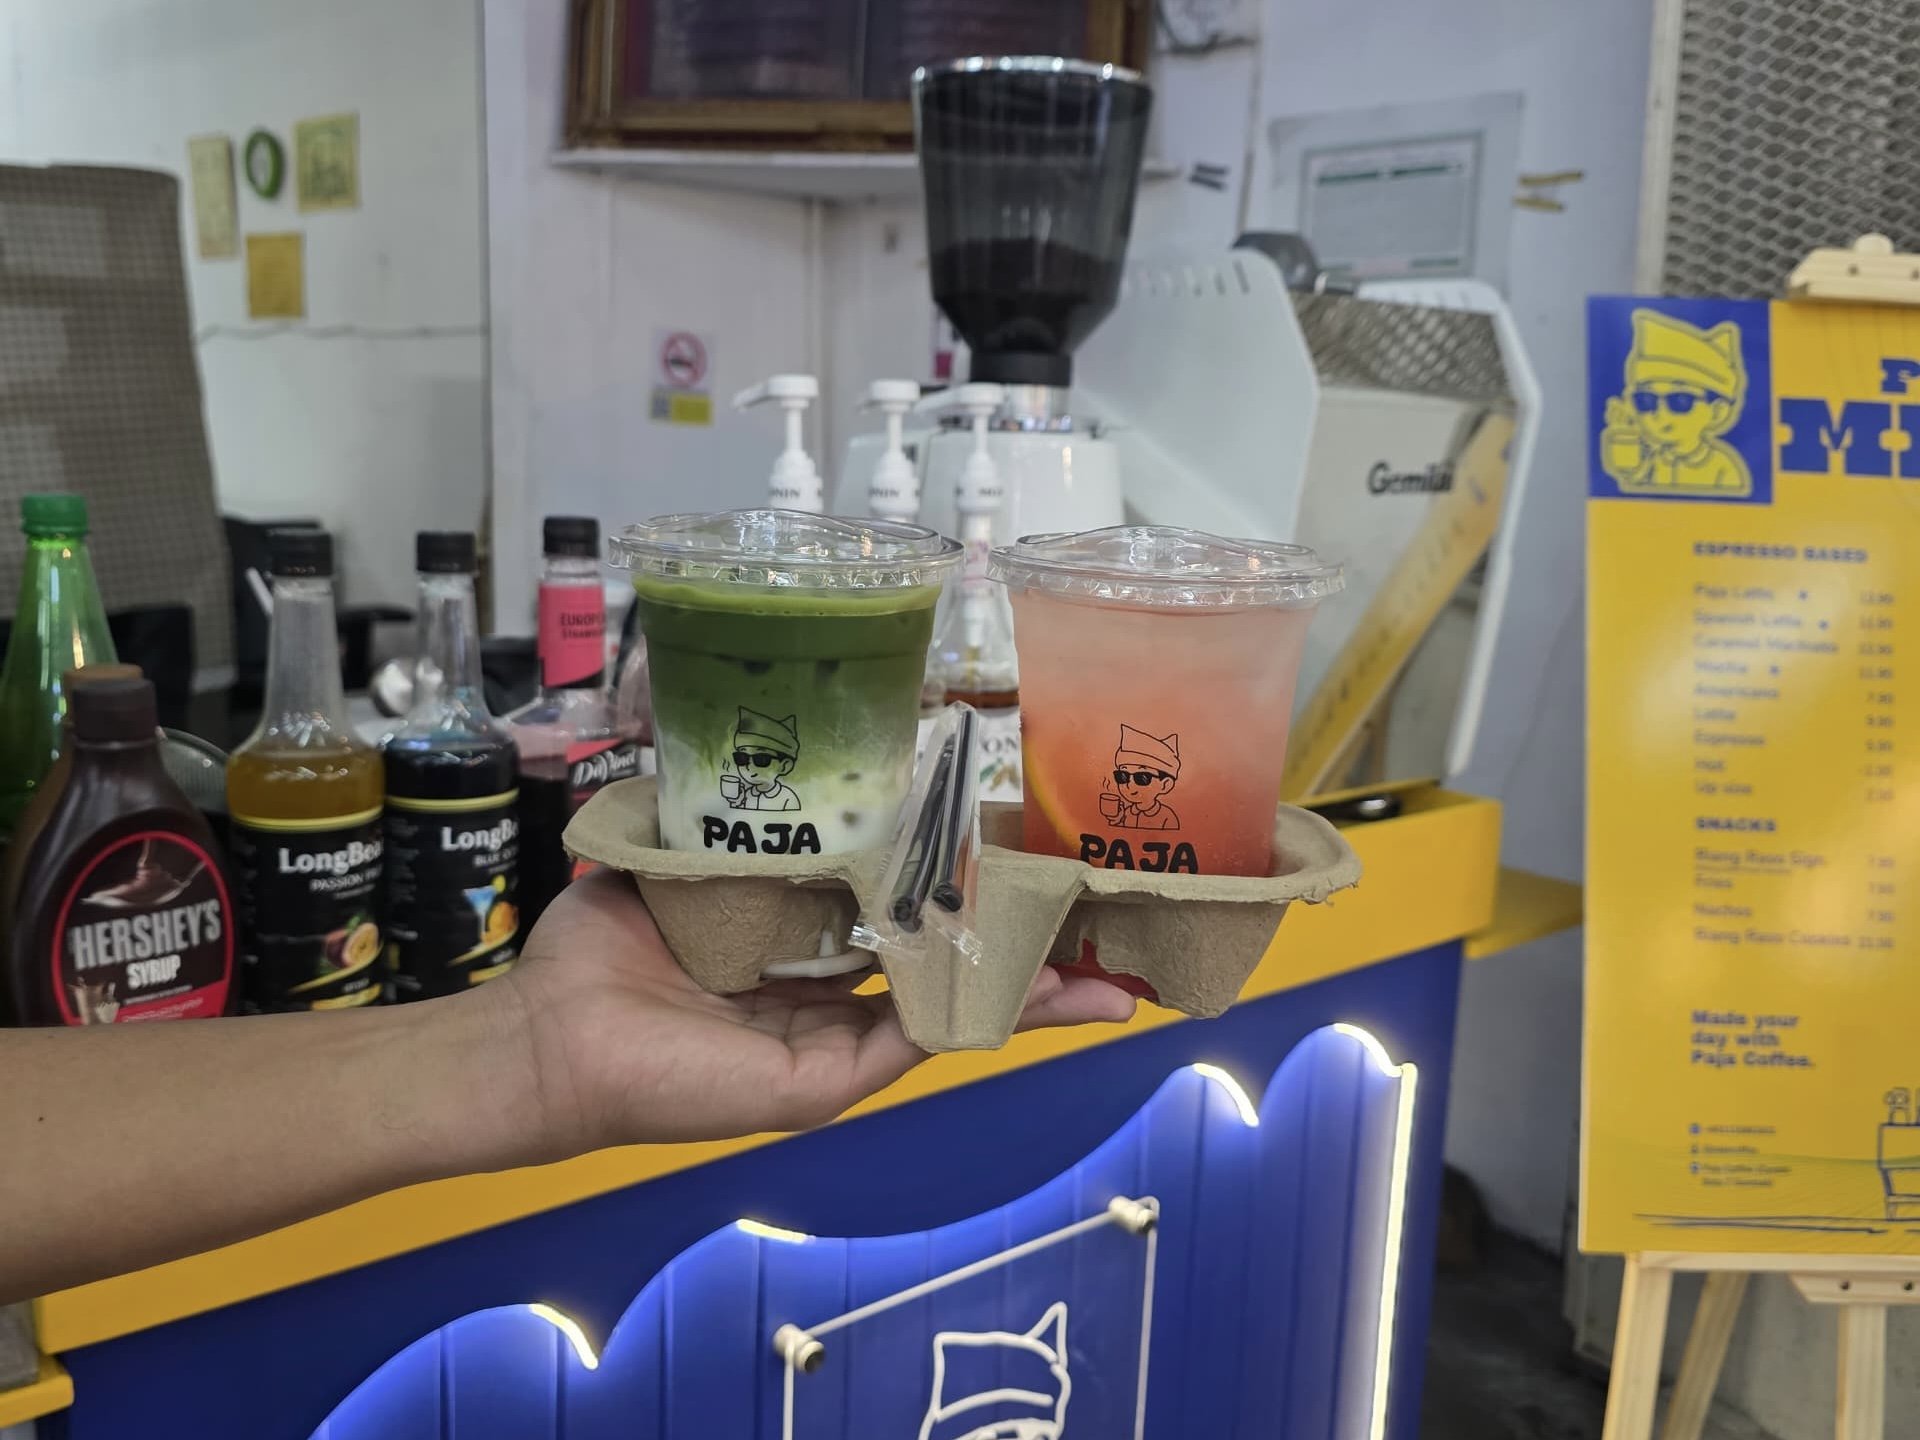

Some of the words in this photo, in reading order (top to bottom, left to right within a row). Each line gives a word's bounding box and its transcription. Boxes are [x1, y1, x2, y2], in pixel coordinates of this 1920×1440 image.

[1694, 543, 1797, 559] ESPRESSO
[1803, 547, 1867, 563] BASED
[703, 815, 821, 854] PAJA
[1695, 817, 1776, 832] SNACKS
[1080, 833, 1198, 874] PAJA
[72, 898, 222, 970] HERSHEY'S
[126, 953, 182, 989] SYRUP
[1692, 1010, 1746, 1025] Made
[1754, 1014, 1799, 1029] your
[1692, 1031, 1727, 1047] day
[1736, 1033, 1779, 1047] with
[1692, 1051, 1736, 1069] Paja
